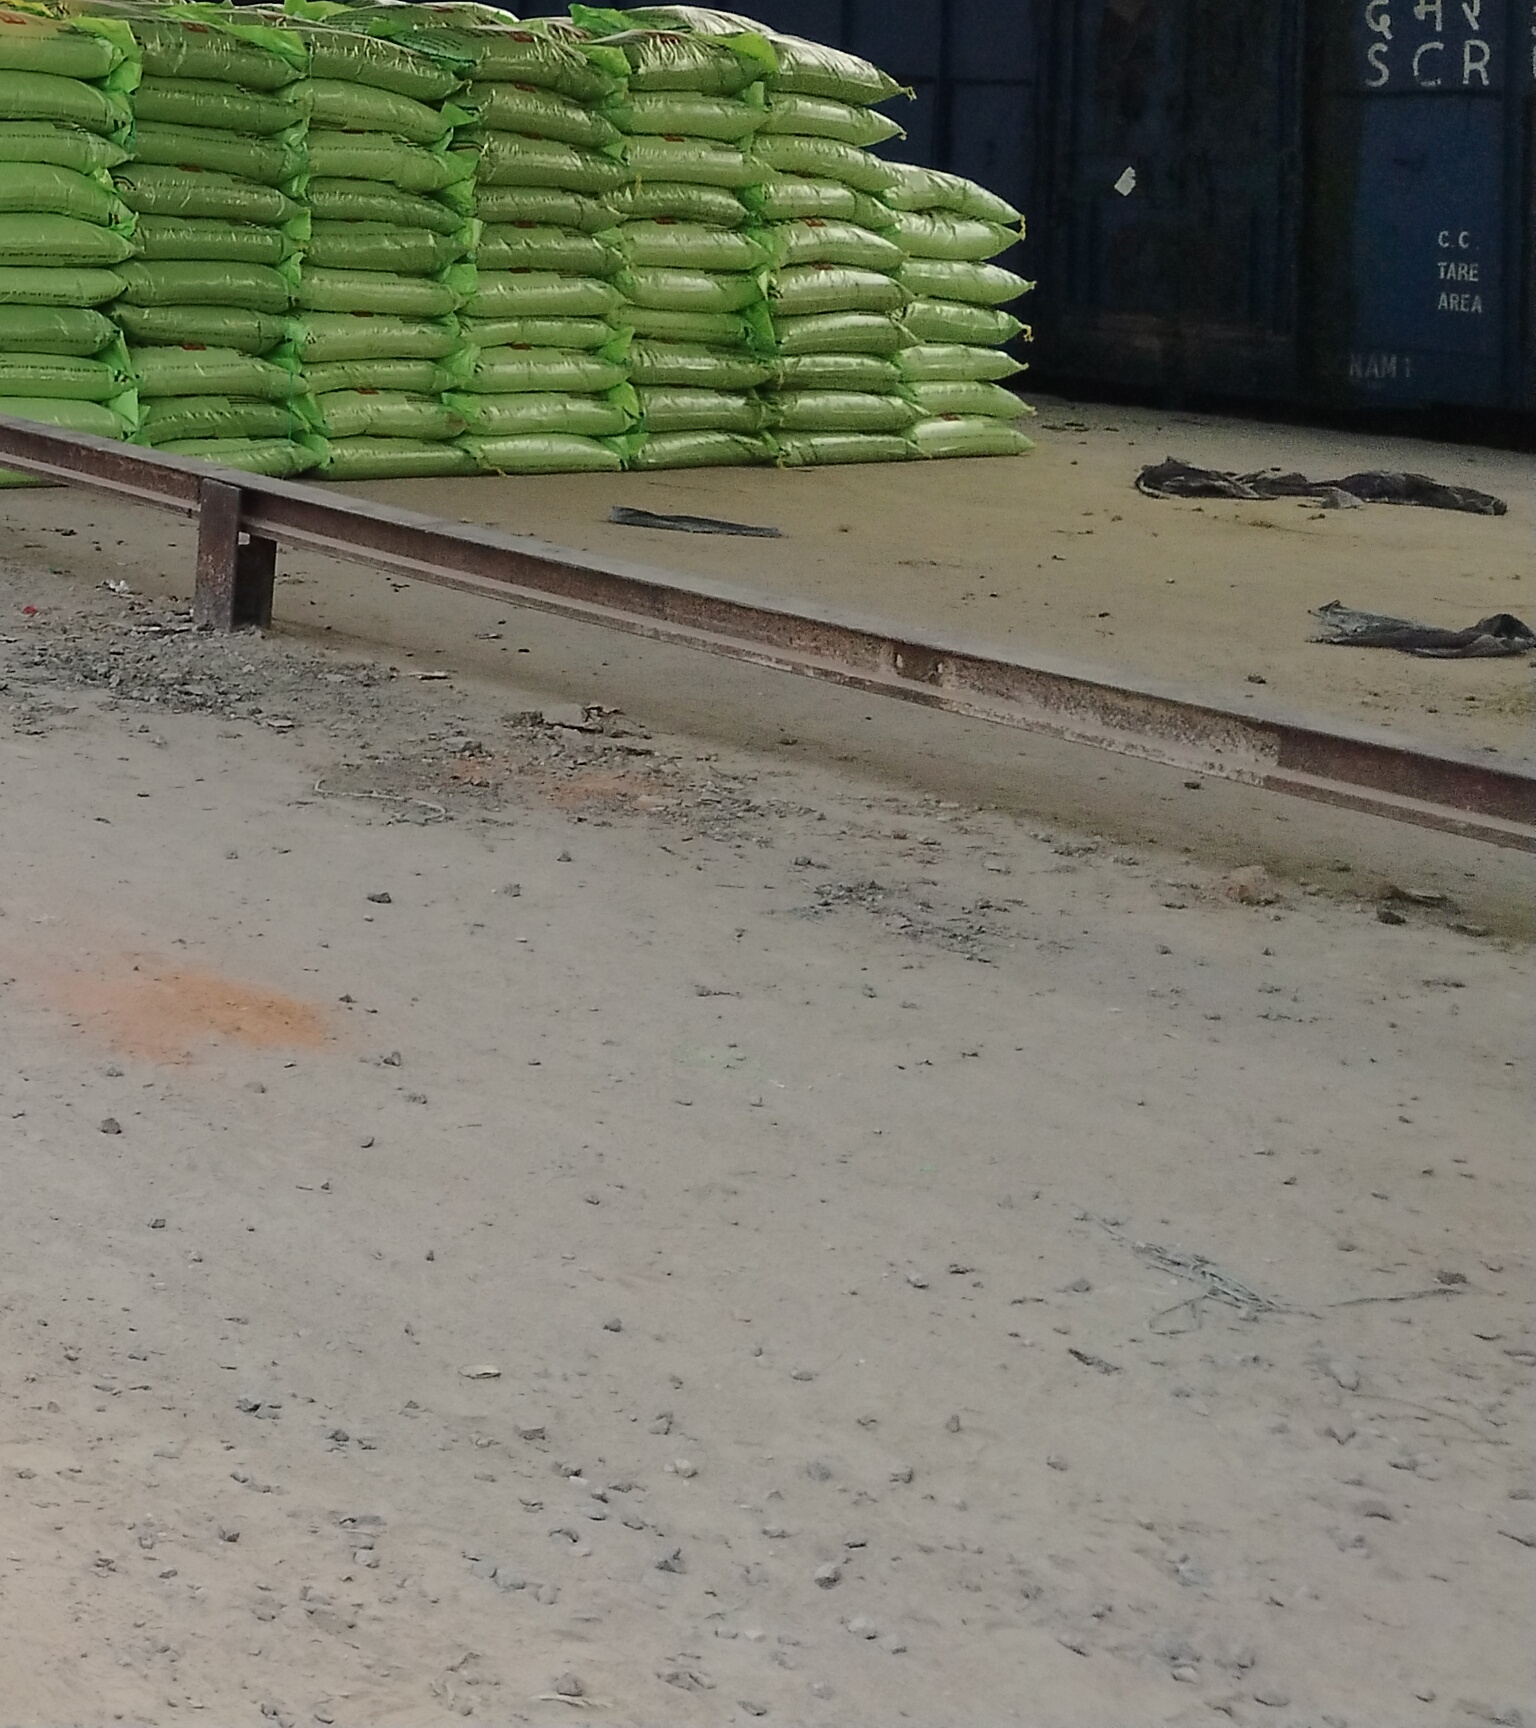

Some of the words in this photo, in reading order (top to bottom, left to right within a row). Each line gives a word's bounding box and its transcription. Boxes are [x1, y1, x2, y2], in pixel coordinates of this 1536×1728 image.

[1365, 39, 1491, 87] SCR
[1437, 261, 1479, 282] TARE
[1438, 291, 1483, 314] AREA
